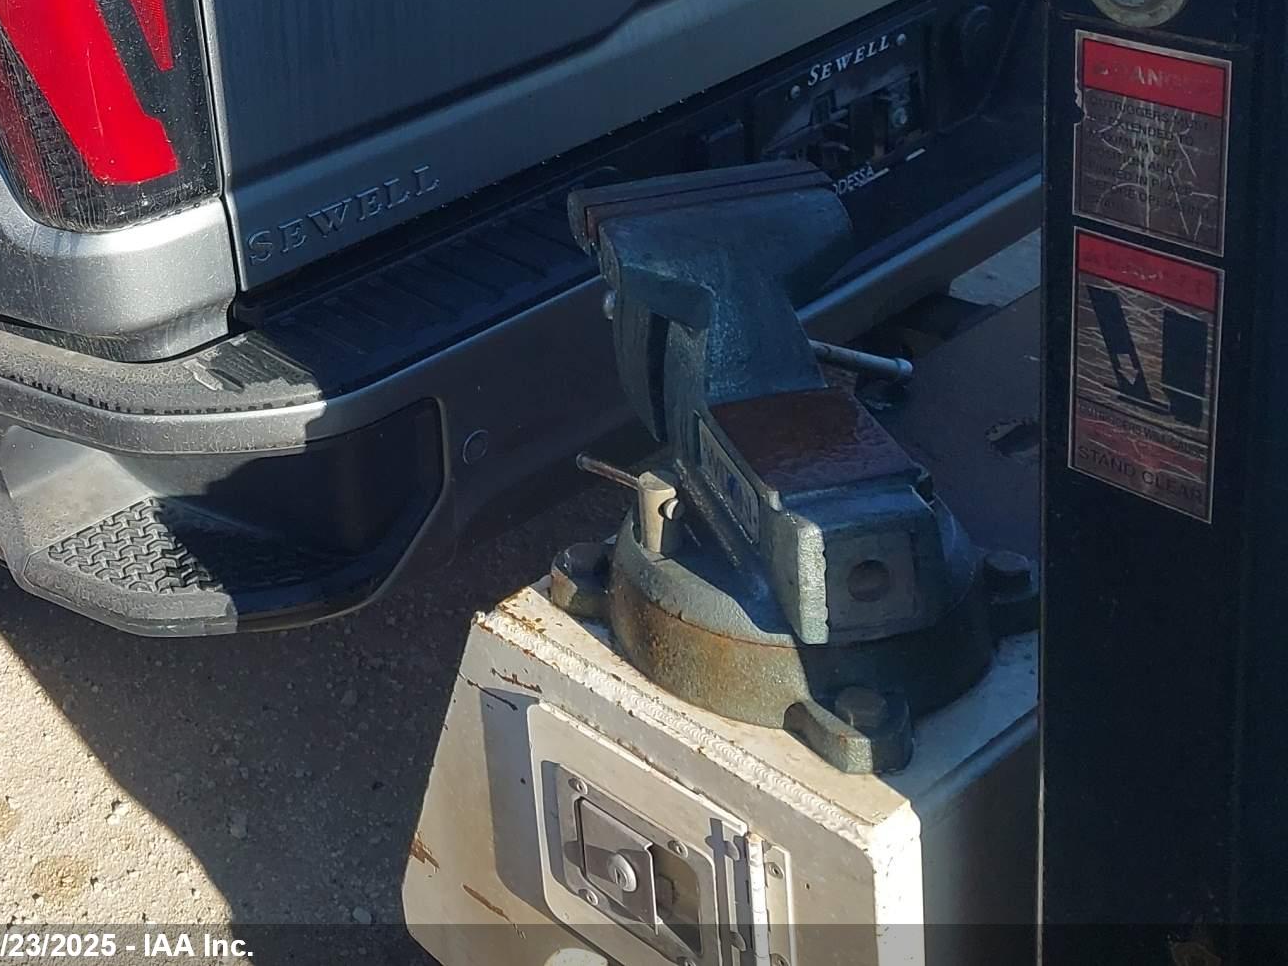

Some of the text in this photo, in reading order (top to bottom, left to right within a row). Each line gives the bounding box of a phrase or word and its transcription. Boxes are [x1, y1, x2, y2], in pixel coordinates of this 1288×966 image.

[808, 35, 890, 86] SEWELL
[247, 165, 440, 265] SEWELL
[1078, 445, 1136, 479] STAND
